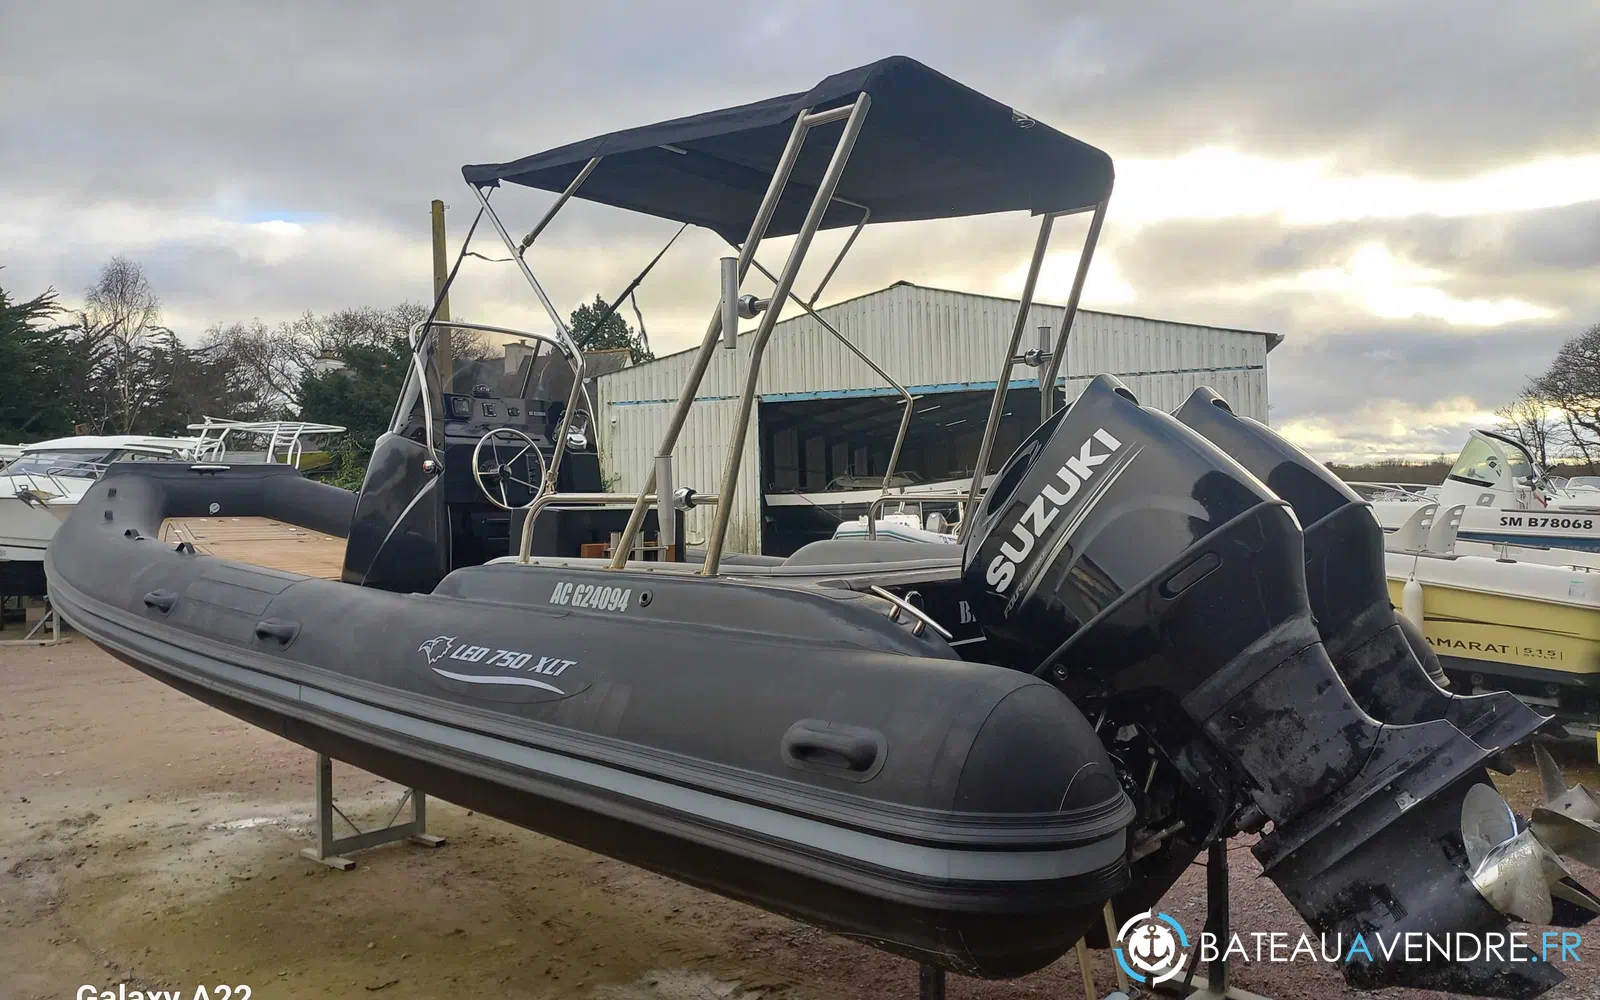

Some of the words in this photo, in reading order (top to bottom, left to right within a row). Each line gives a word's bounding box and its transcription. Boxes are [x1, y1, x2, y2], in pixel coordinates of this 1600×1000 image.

[986, 428, 1122, 593] SUZUKI
[1500, 516, 1522, 527] SM
[1528, 517, 1593, 529] B78068
[549, 582, 571, 606] AC
[572, 585, 632, 612] G24094
[450, 644, 491, 663] LED
[486, 650, 533, 670] 750
[527, 656, 578, 677] XLT
